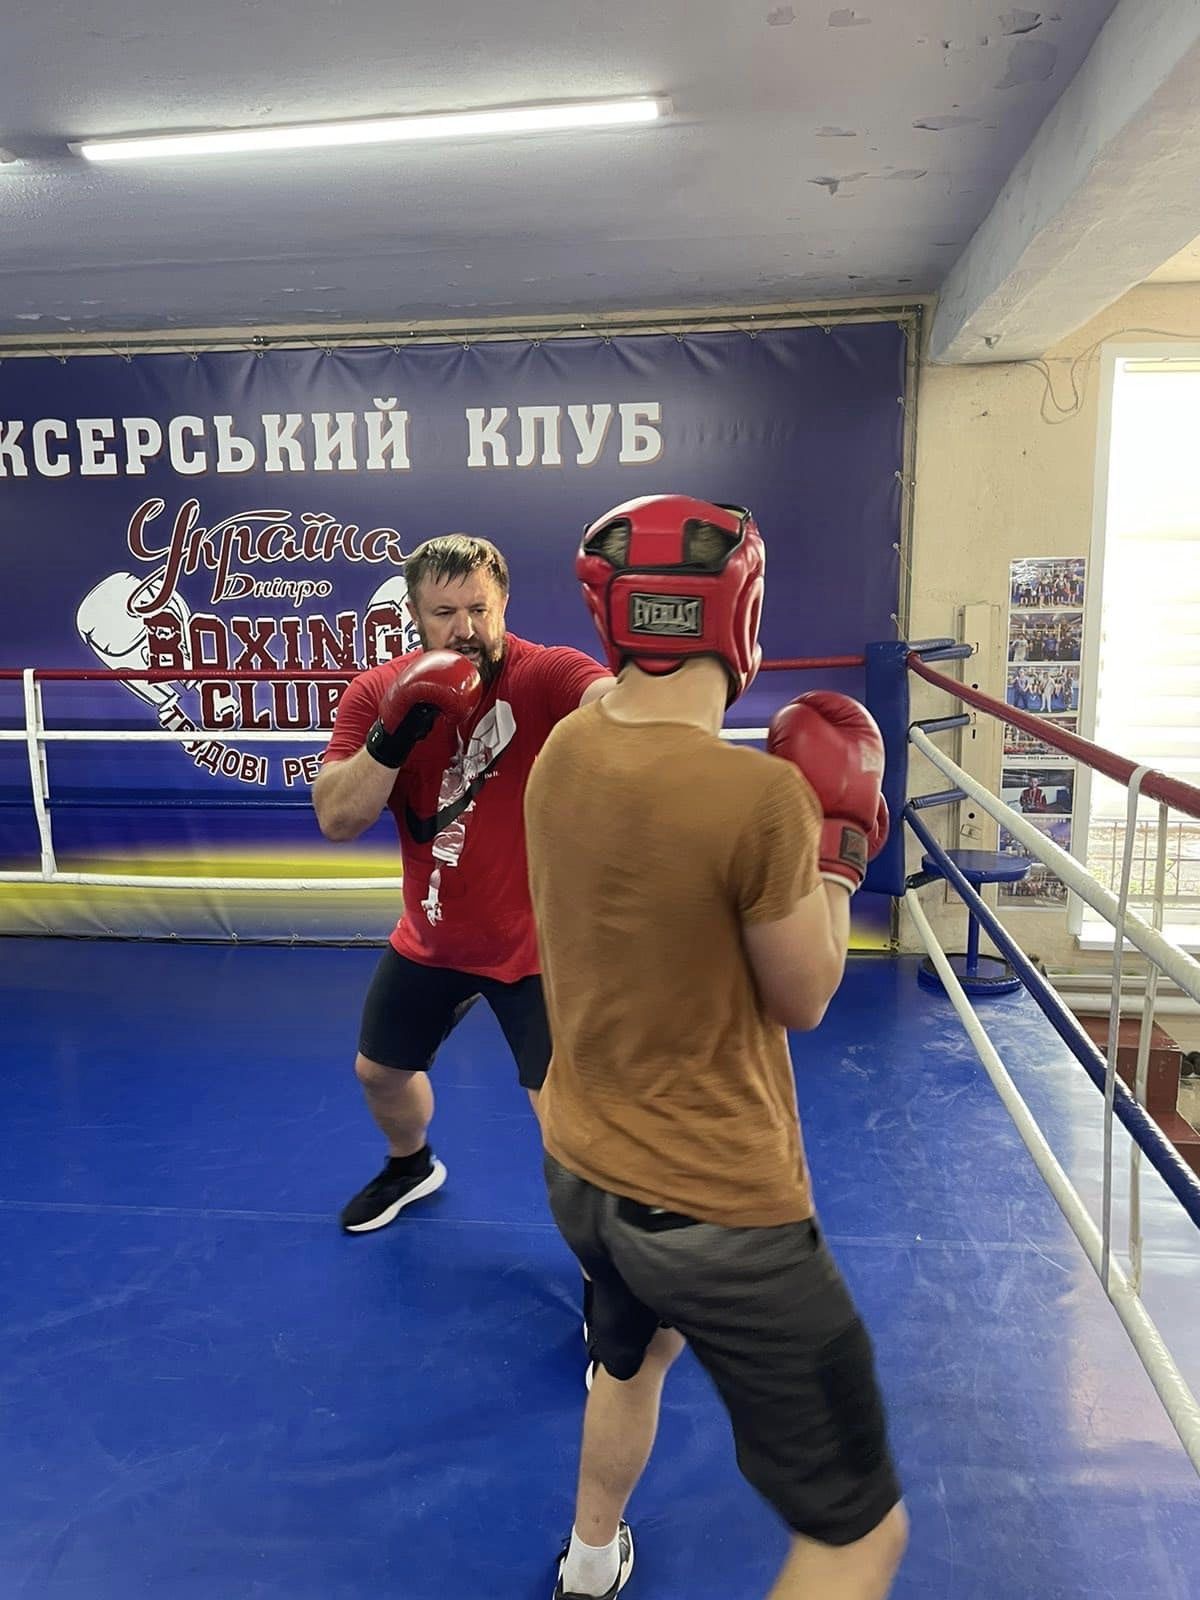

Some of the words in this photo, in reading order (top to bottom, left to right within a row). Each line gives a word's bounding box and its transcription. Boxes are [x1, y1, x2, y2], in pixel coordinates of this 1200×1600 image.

[0, 397, 411, 478] КСЕРСЬКИЙ
[465, 402, 663, 467] КЛУБ
[127, 498, 406, 615] Україна
[221, 573, 332, 607] Дніпро
[282, 750, 327, 787] РЕ
